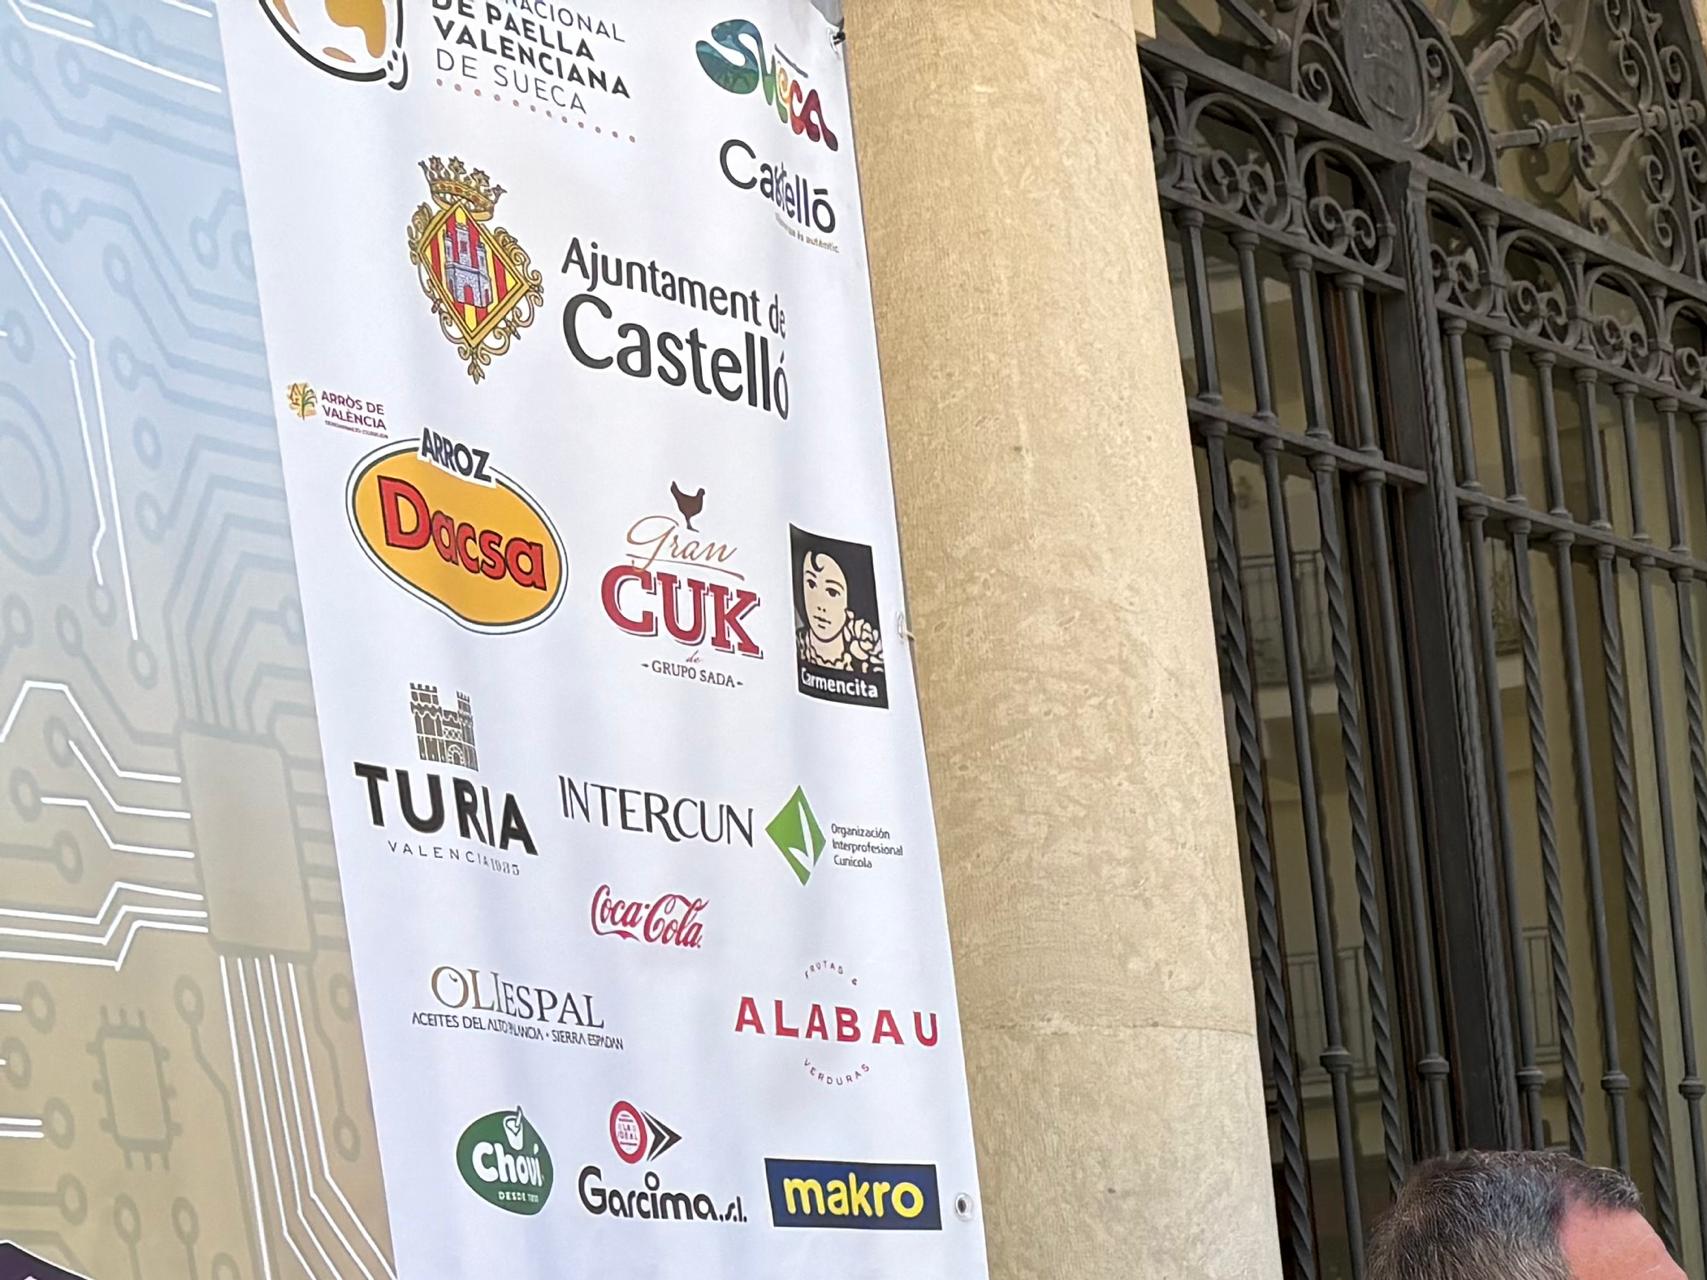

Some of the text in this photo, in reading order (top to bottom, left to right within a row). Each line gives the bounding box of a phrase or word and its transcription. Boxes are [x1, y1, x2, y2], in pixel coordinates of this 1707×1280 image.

[486, 2, 595, 62] PAELLA
[433, 15, 631, 99] VALENCIANA
[436, 48, 587, 115] DE SUECA
[560, 237, 787, 341] Ajuntament de
[562, 293, 790, 420] Castelló
[321, 389, 384, 415] ARRÒS DE
[322, 405, 387, 430] VALÈNCIA
[421, 427, 492, 482] ARROZ
[377, 475, 548, 591] Dacsa
[626, 514, 738, 572] Gran
[600, 564, 764, 660] CUK
[651, 660, 736, 688] GRUPO SADA
[800, 667, 879, 698] Carmencita
[353, 761, 539, 857] TURIA
[558, 774, 753, 848] INTERCUN
[831, 823, 891, 839] Organización
[387, 840, 489, 866] VALENCIA
[832, 838, 904, 856] Interprofesional
[804, 960, 844, 979] FRUTAS
[412, 1011, 459, 1028] ACEITES
[463, 1015, 486, 1031] DEL
[551, 1029, 587, 1045] SIERRA
[735, 995, 938, 1047] ALABAU
[804, 1058, 870, 1086] VERDURAS
[472, 1141, 543, 1187] Choví
[783, 1171, 925, 1218] makro
